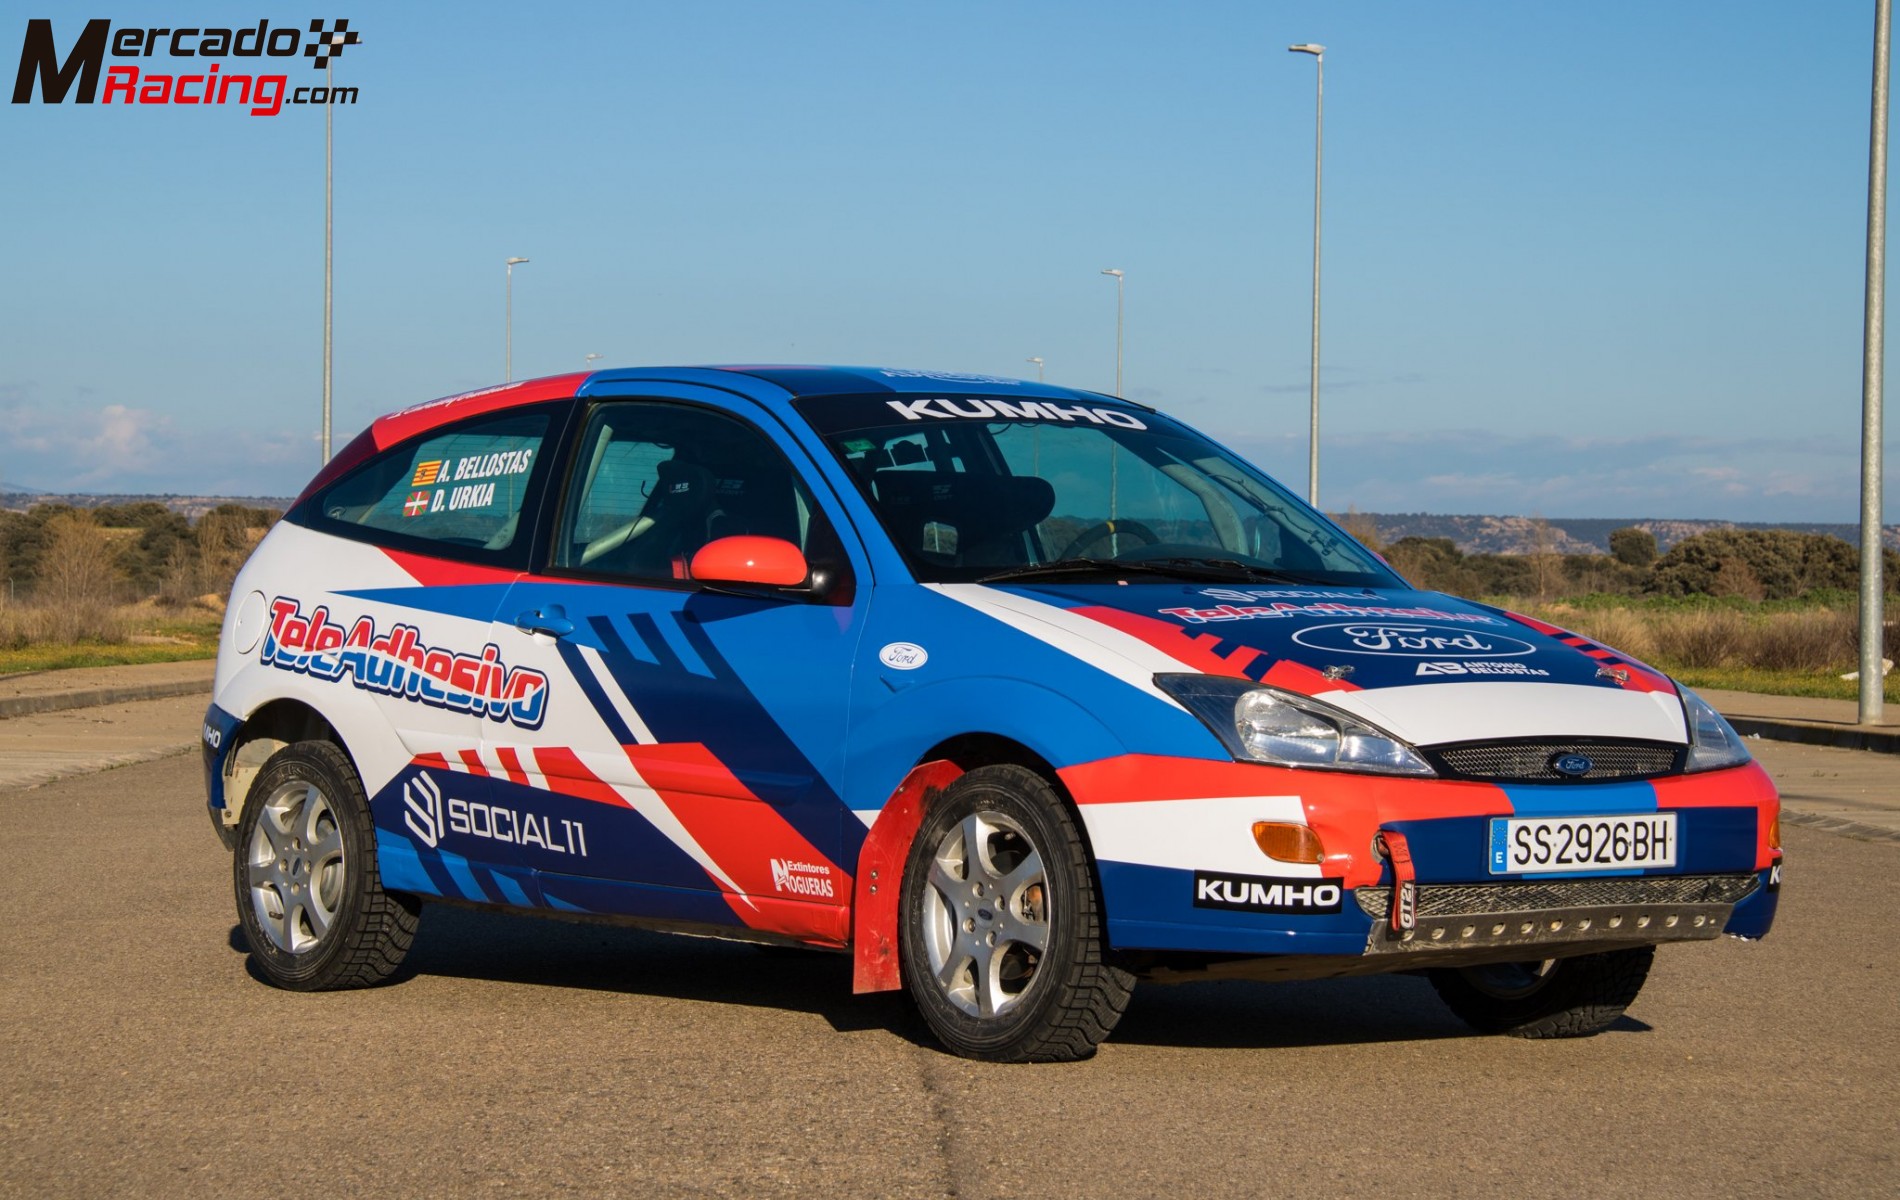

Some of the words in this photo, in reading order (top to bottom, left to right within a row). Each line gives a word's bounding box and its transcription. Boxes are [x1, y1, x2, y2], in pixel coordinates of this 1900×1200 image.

[886, 399, 1147, 431] KUMHO
[436, 460, 450, 483] A.
[454, 449, 532, 481] BELLOSTAS
[431, 489, 445, 512] D.
[449, 483, 495, 511] URKIA
[1343, 627, 1492, 650] Ford
[260, 596, 549, 731] TeleAdhesivo
[889, 646, 918, 664] Ford
[1463, 661, 1527, 669] ANTONIO
[1468, 667, 1550, 676] BELLOSTAS
[1565, 758, 1585, 769] Ford
[448, 798, 587, 857] SOCIAL11
[787, 860, 830, 875] Extintores
[1495, 852, 1503, 863] E
[1198, 879, 1340, 907] KUMHO
